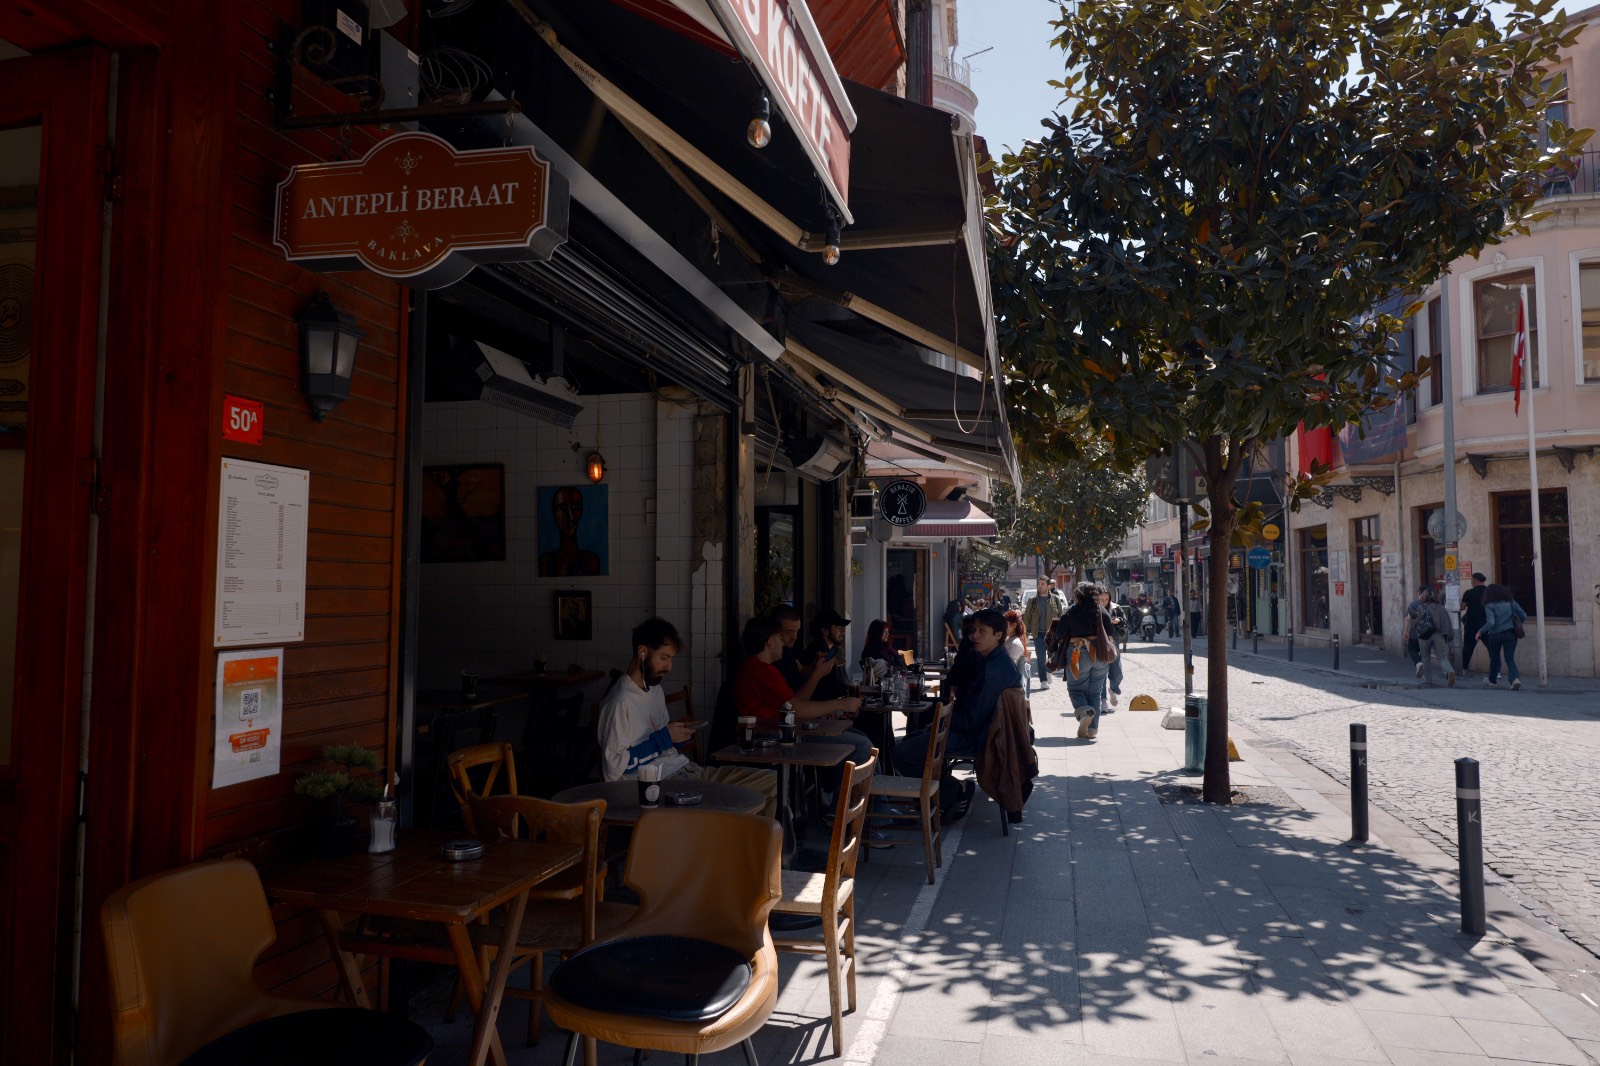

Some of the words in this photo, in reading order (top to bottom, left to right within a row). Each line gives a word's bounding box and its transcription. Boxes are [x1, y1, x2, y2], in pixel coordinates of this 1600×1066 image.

[302, 185, 408, 219] ANTEPLİ
[416, 182, 519, 211] BERAAT
[366, 235, 444, 261] BAKLAVA
[890, 515, 914, 524] COFFEE
[1468, 810, 1480, 824] K
